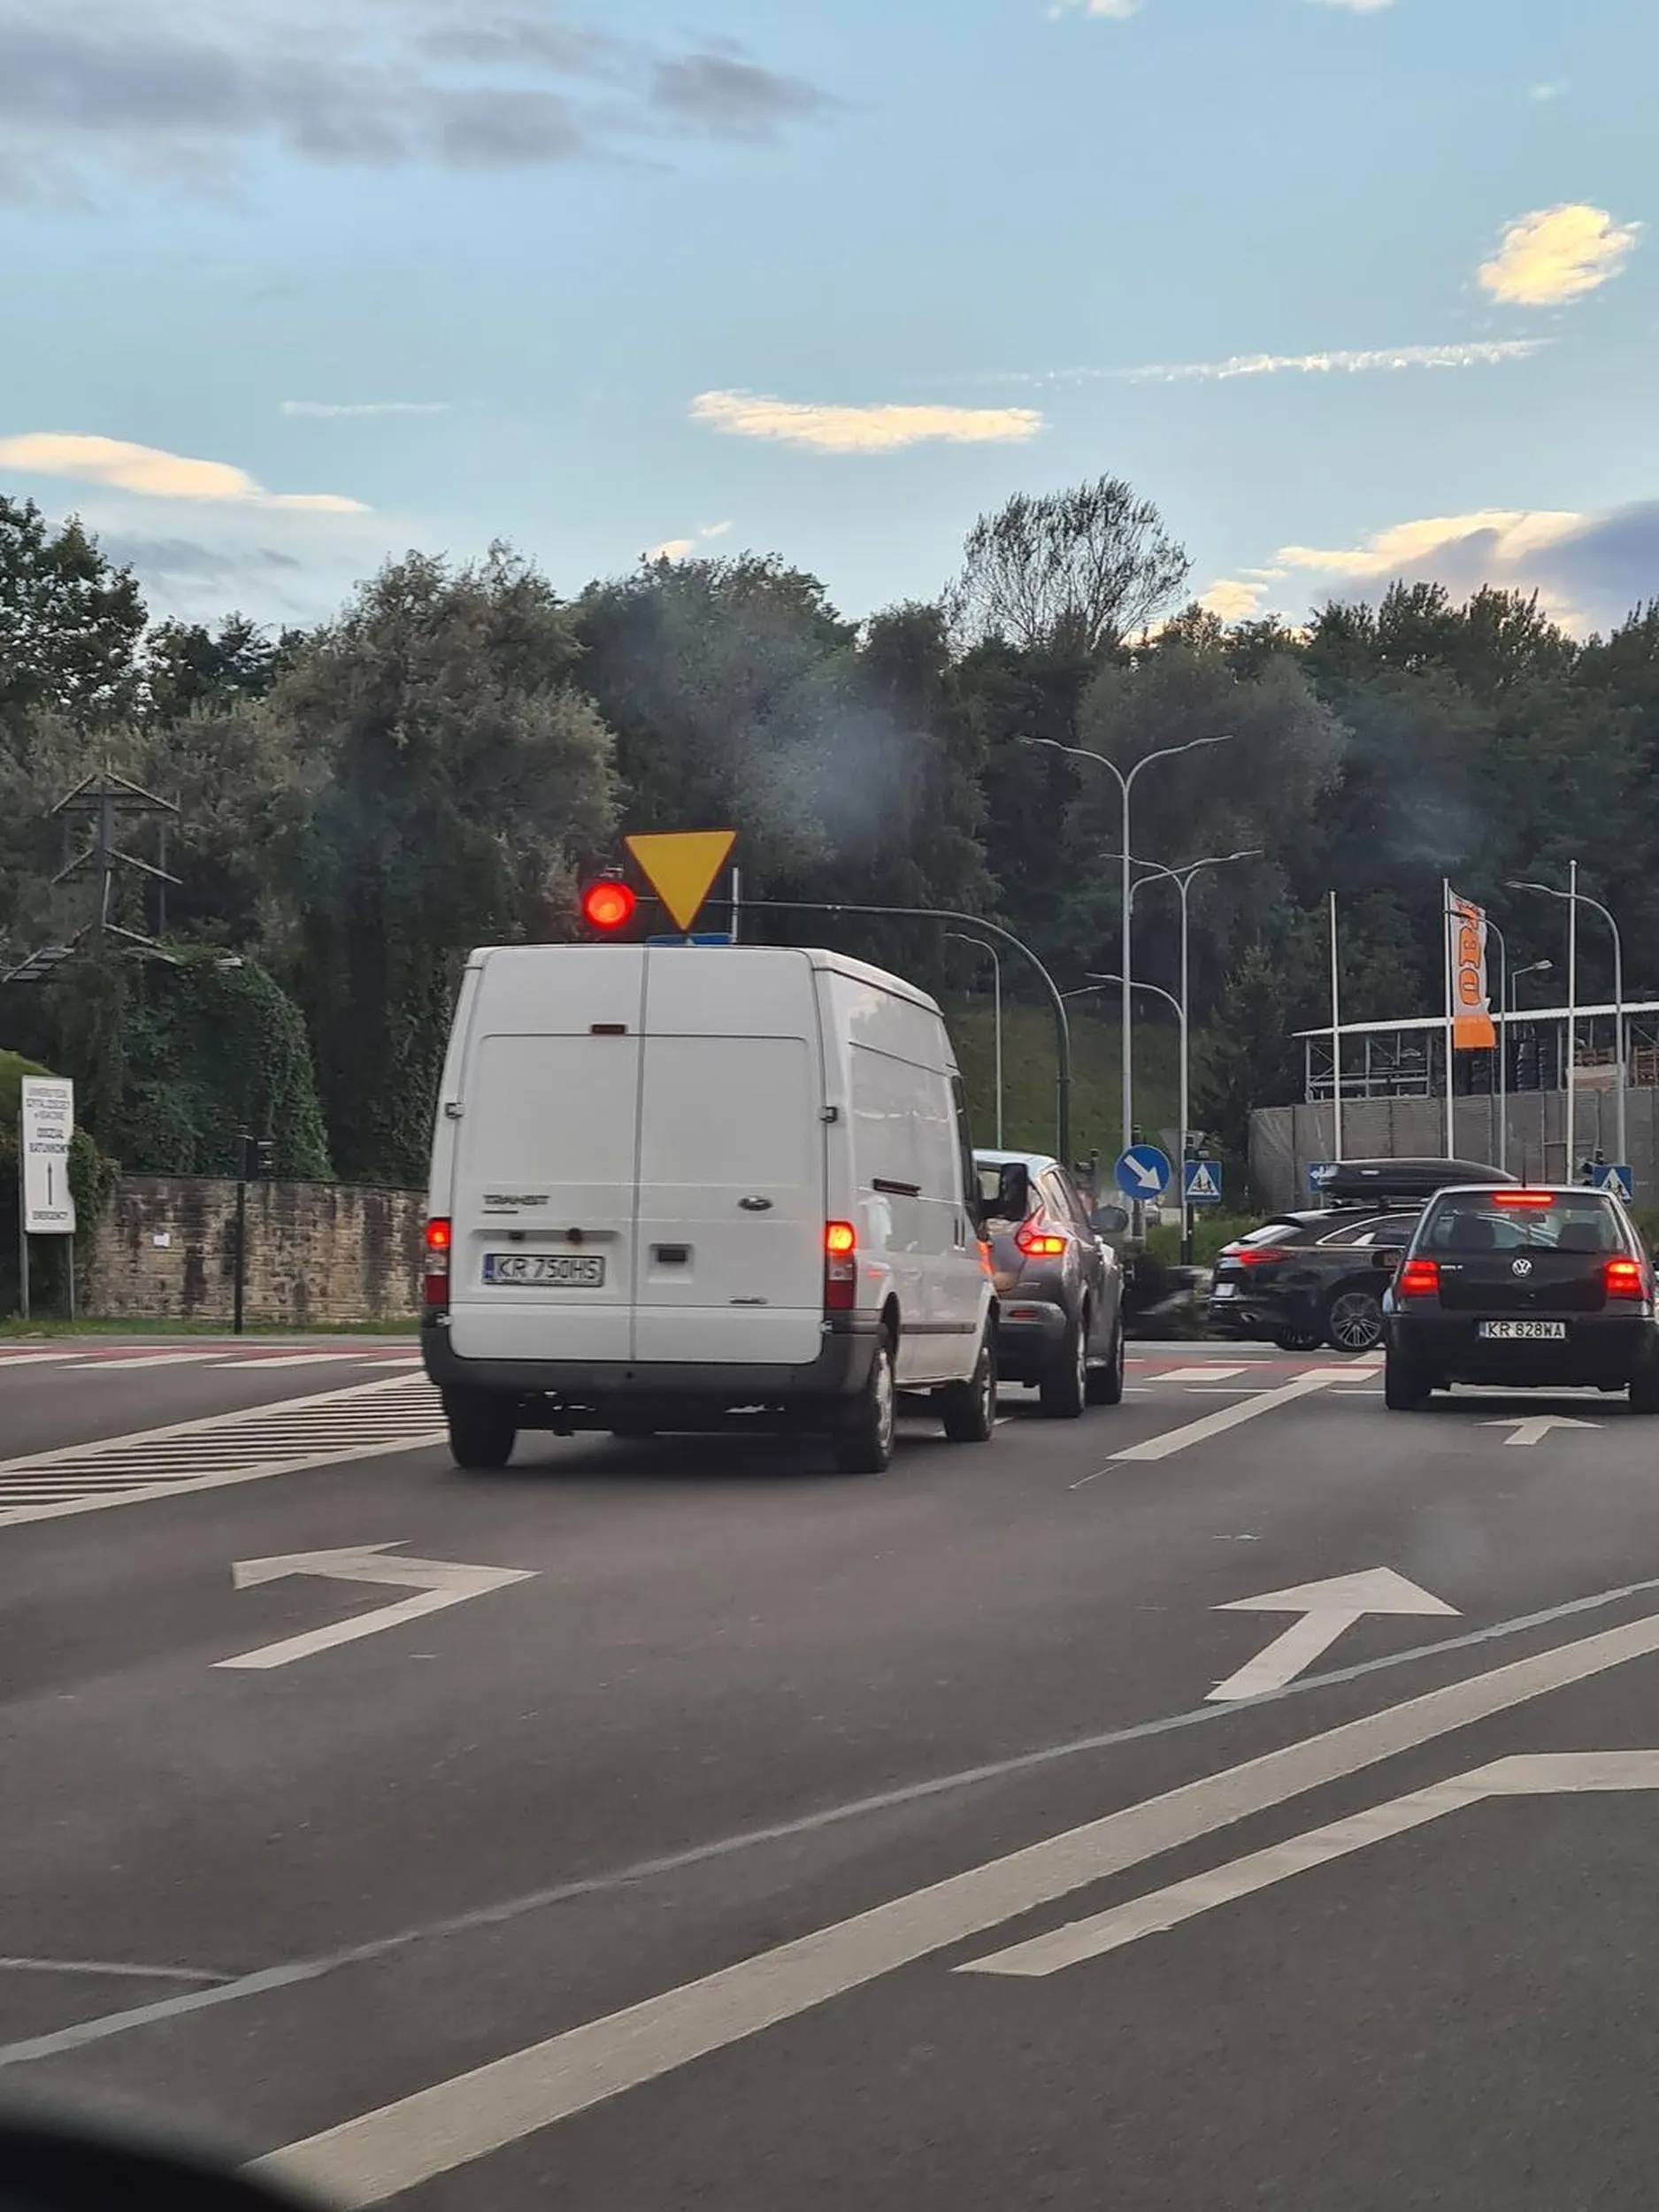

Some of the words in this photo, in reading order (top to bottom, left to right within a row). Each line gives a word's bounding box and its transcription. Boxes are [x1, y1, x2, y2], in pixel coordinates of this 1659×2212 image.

[497, 1258, 526, 1278] KR
[534, 1259, 598, 1279] 750HS
[1488, 1322, 1510, 1337] KR
